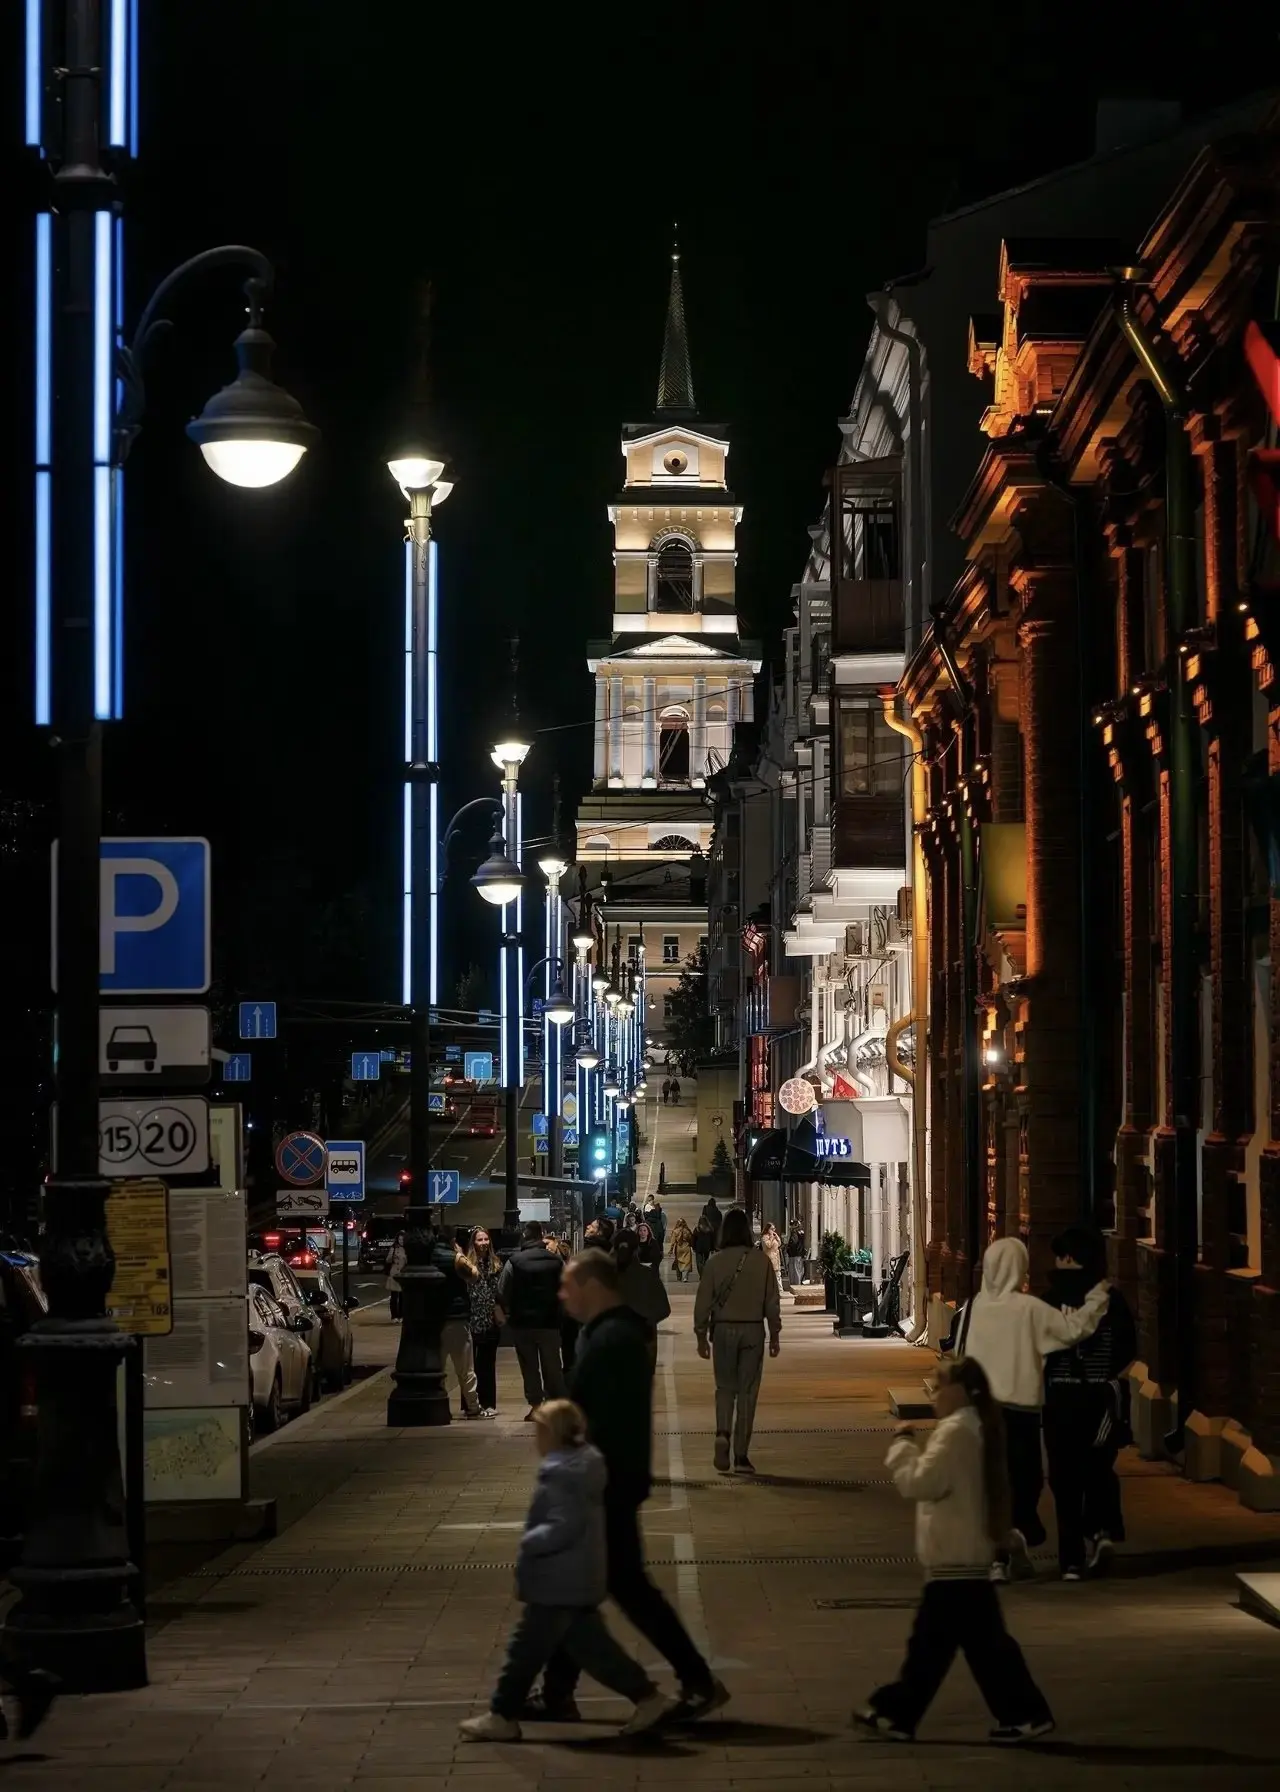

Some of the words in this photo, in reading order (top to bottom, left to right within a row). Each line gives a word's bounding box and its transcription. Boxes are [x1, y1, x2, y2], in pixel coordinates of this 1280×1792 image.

[99, 857, 180, 975] P
[104, 1126, 131, 1153] 15
[145, 1122, 188, 1153] 20
